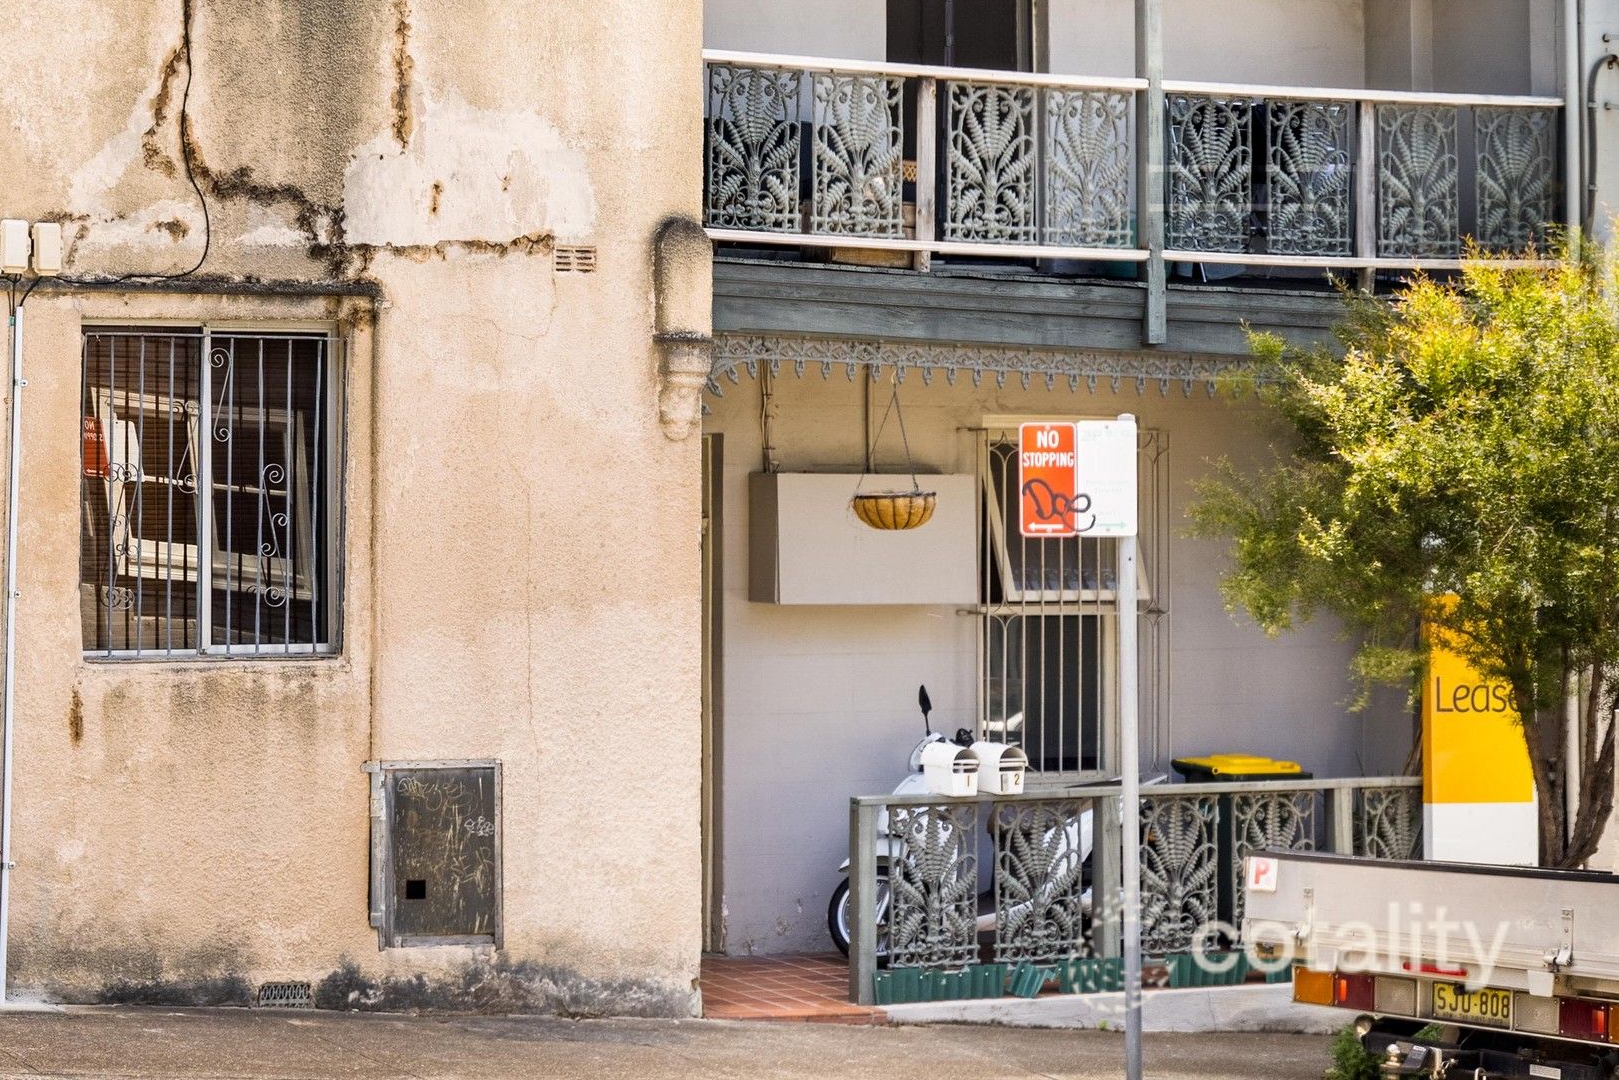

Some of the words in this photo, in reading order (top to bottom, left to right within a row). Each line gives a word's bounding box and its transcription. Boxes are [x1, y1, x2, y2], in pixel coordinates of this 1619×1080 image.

[1036, 430, 1060, 449] NO
[1022, 451, 1075, 468] STOPPING
[1014, 773, 1021, 786] 2
[1254, 859, 1270, 885] P
